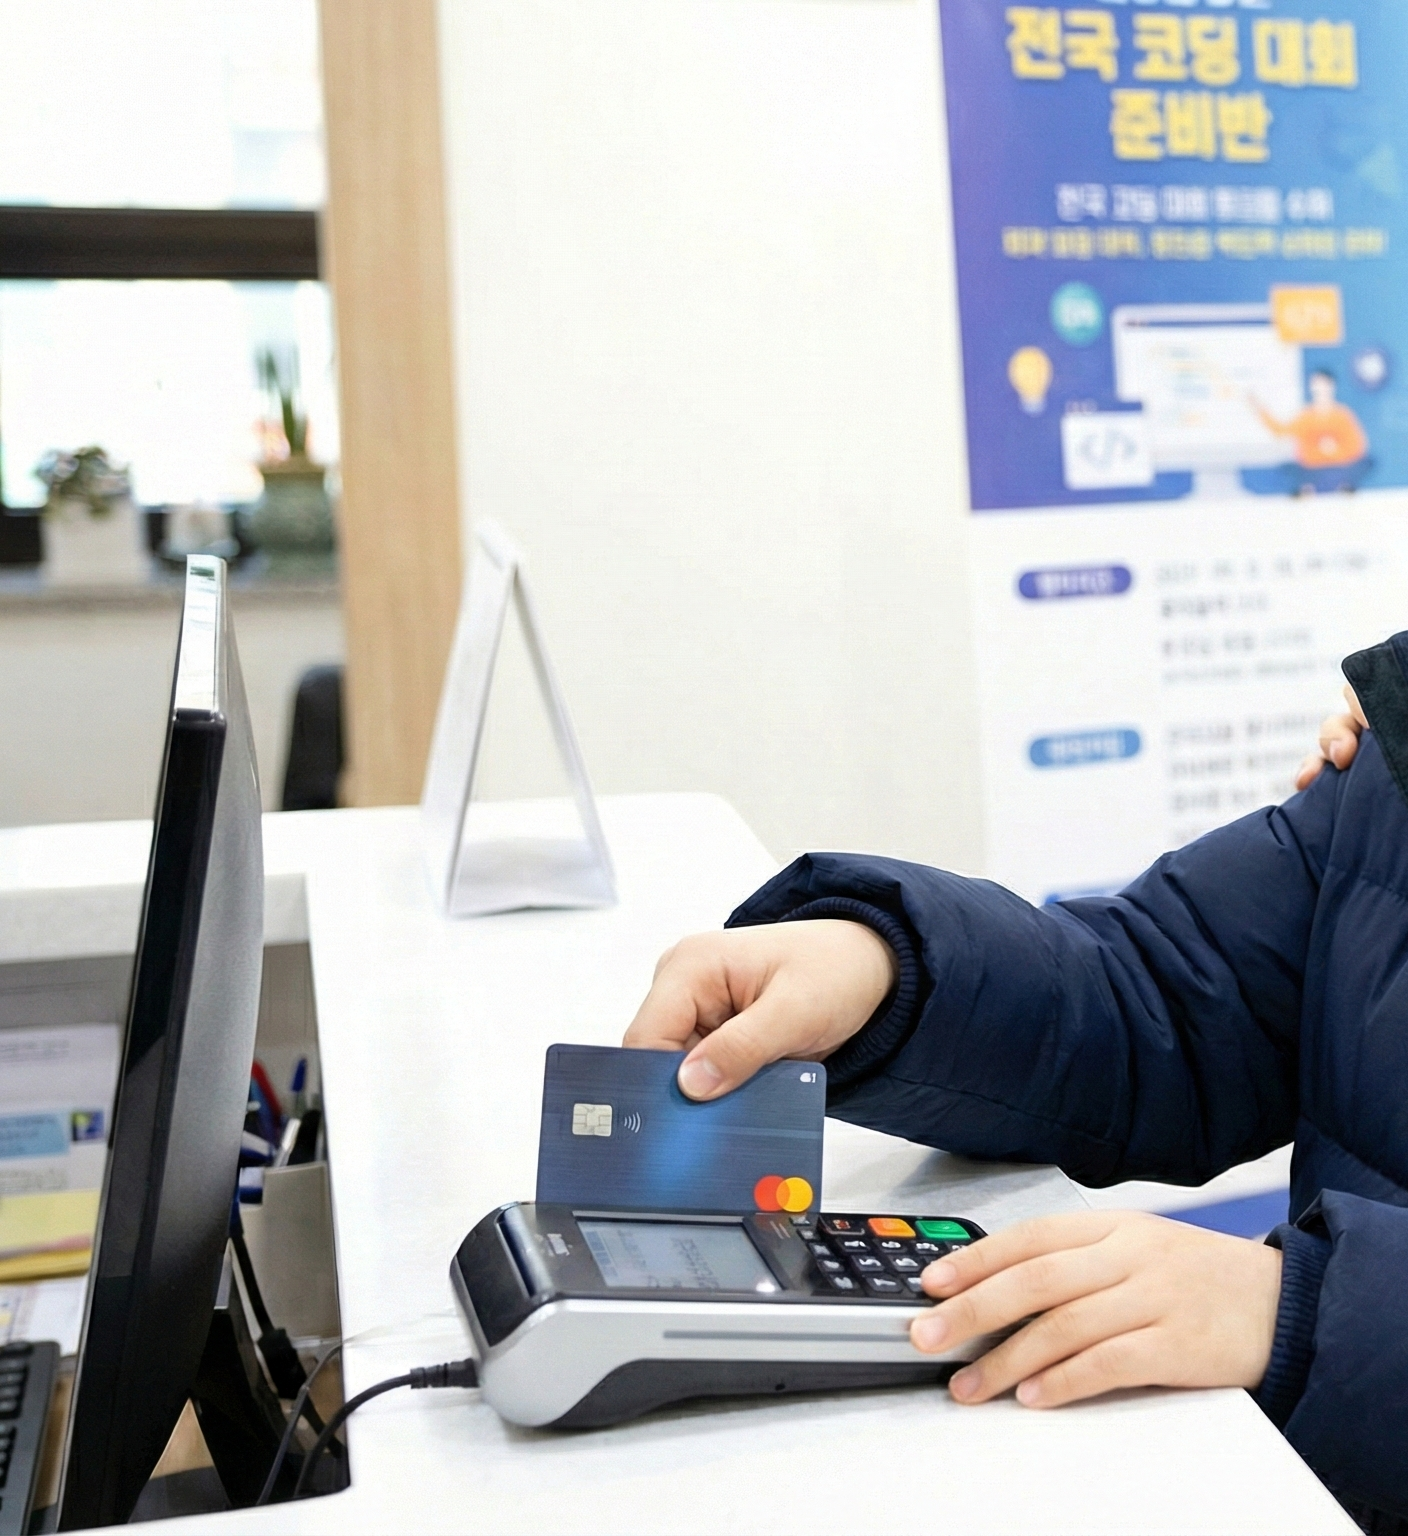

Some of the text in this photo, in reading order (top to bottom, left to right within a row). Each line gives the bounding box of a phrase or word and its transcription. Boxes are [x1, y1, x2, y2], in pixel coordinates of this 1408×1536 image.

[1007, 7, 1359, 88] 전국 코딩 대회
[1110, 89, 1271, 162] 준비반
